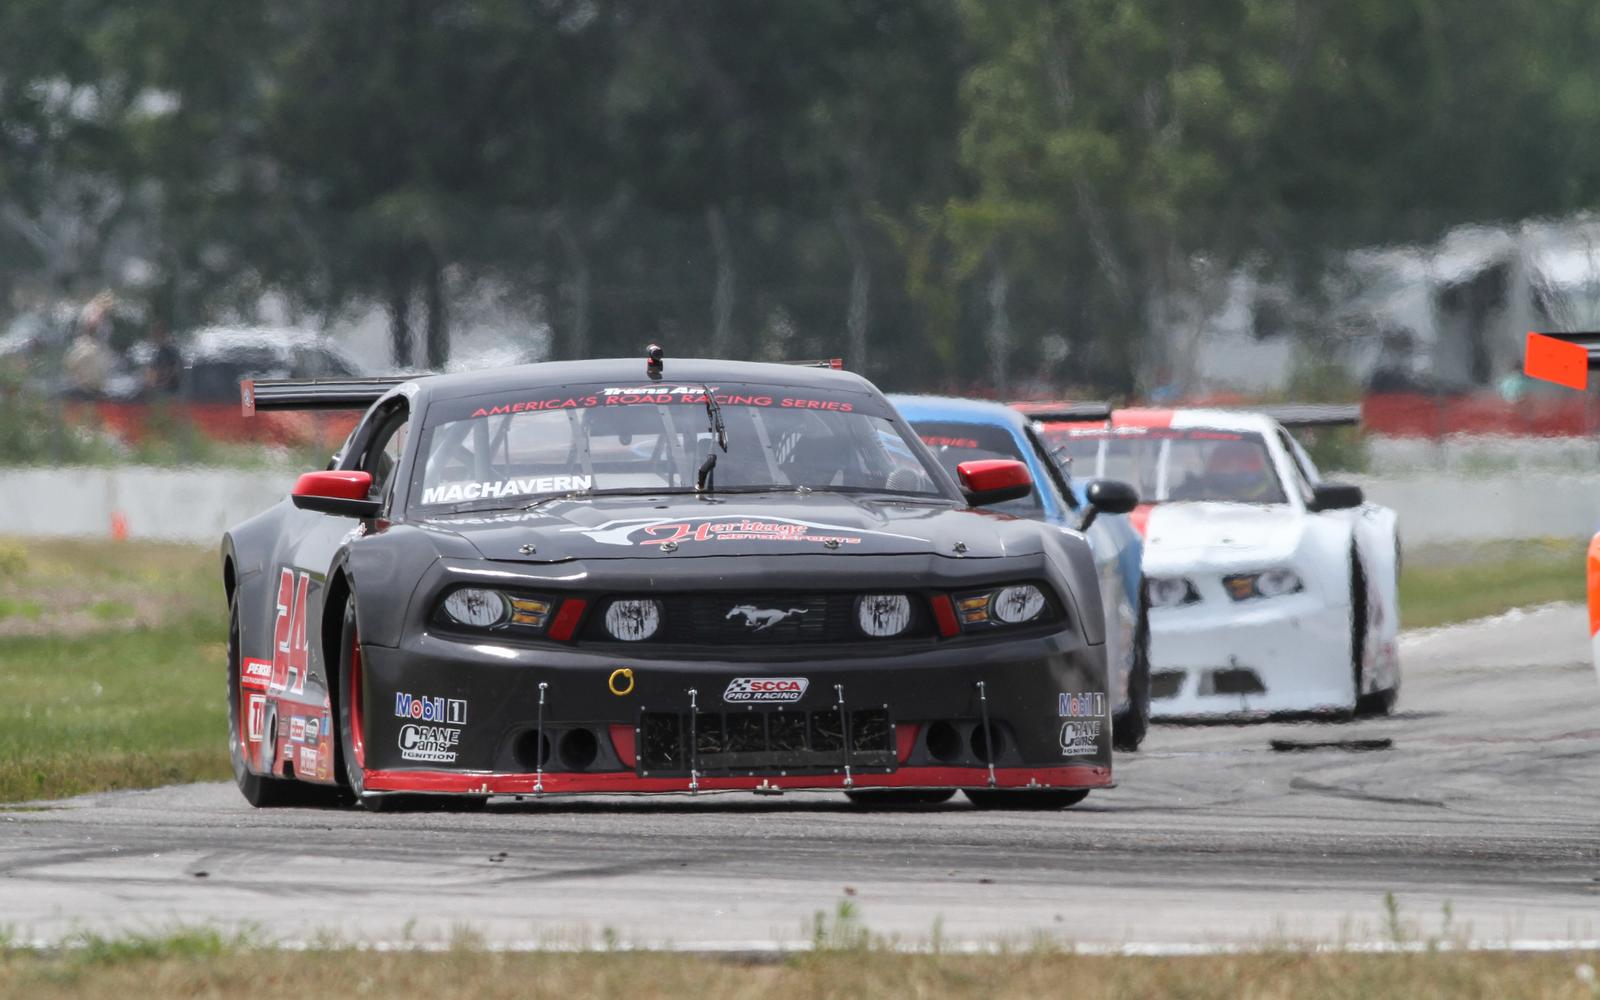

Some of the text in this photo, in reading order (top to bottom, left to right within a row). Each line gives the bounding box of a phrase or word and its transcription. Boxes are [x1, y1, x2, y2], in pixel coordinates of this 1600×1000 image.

[603, 387, 668, 396] Trans
[471, 394, 853, 417] AMERICA'S ROAD RACING SERIES
[421, 475, 592, 505] MACHAVERN
[640, 519, 810, 545] Heritage
[270, 567, 309, 695] 24
[727, 692, 799, 700] PRO RACING
[751, 681, 801, 691] SCCA
[395, 692, 445, 723] Mobil
[1059, 692, 1092, 717] Mobil
[398, 724, 461, 750] CRANE
[402, 750, 455, 761] IGNITION
